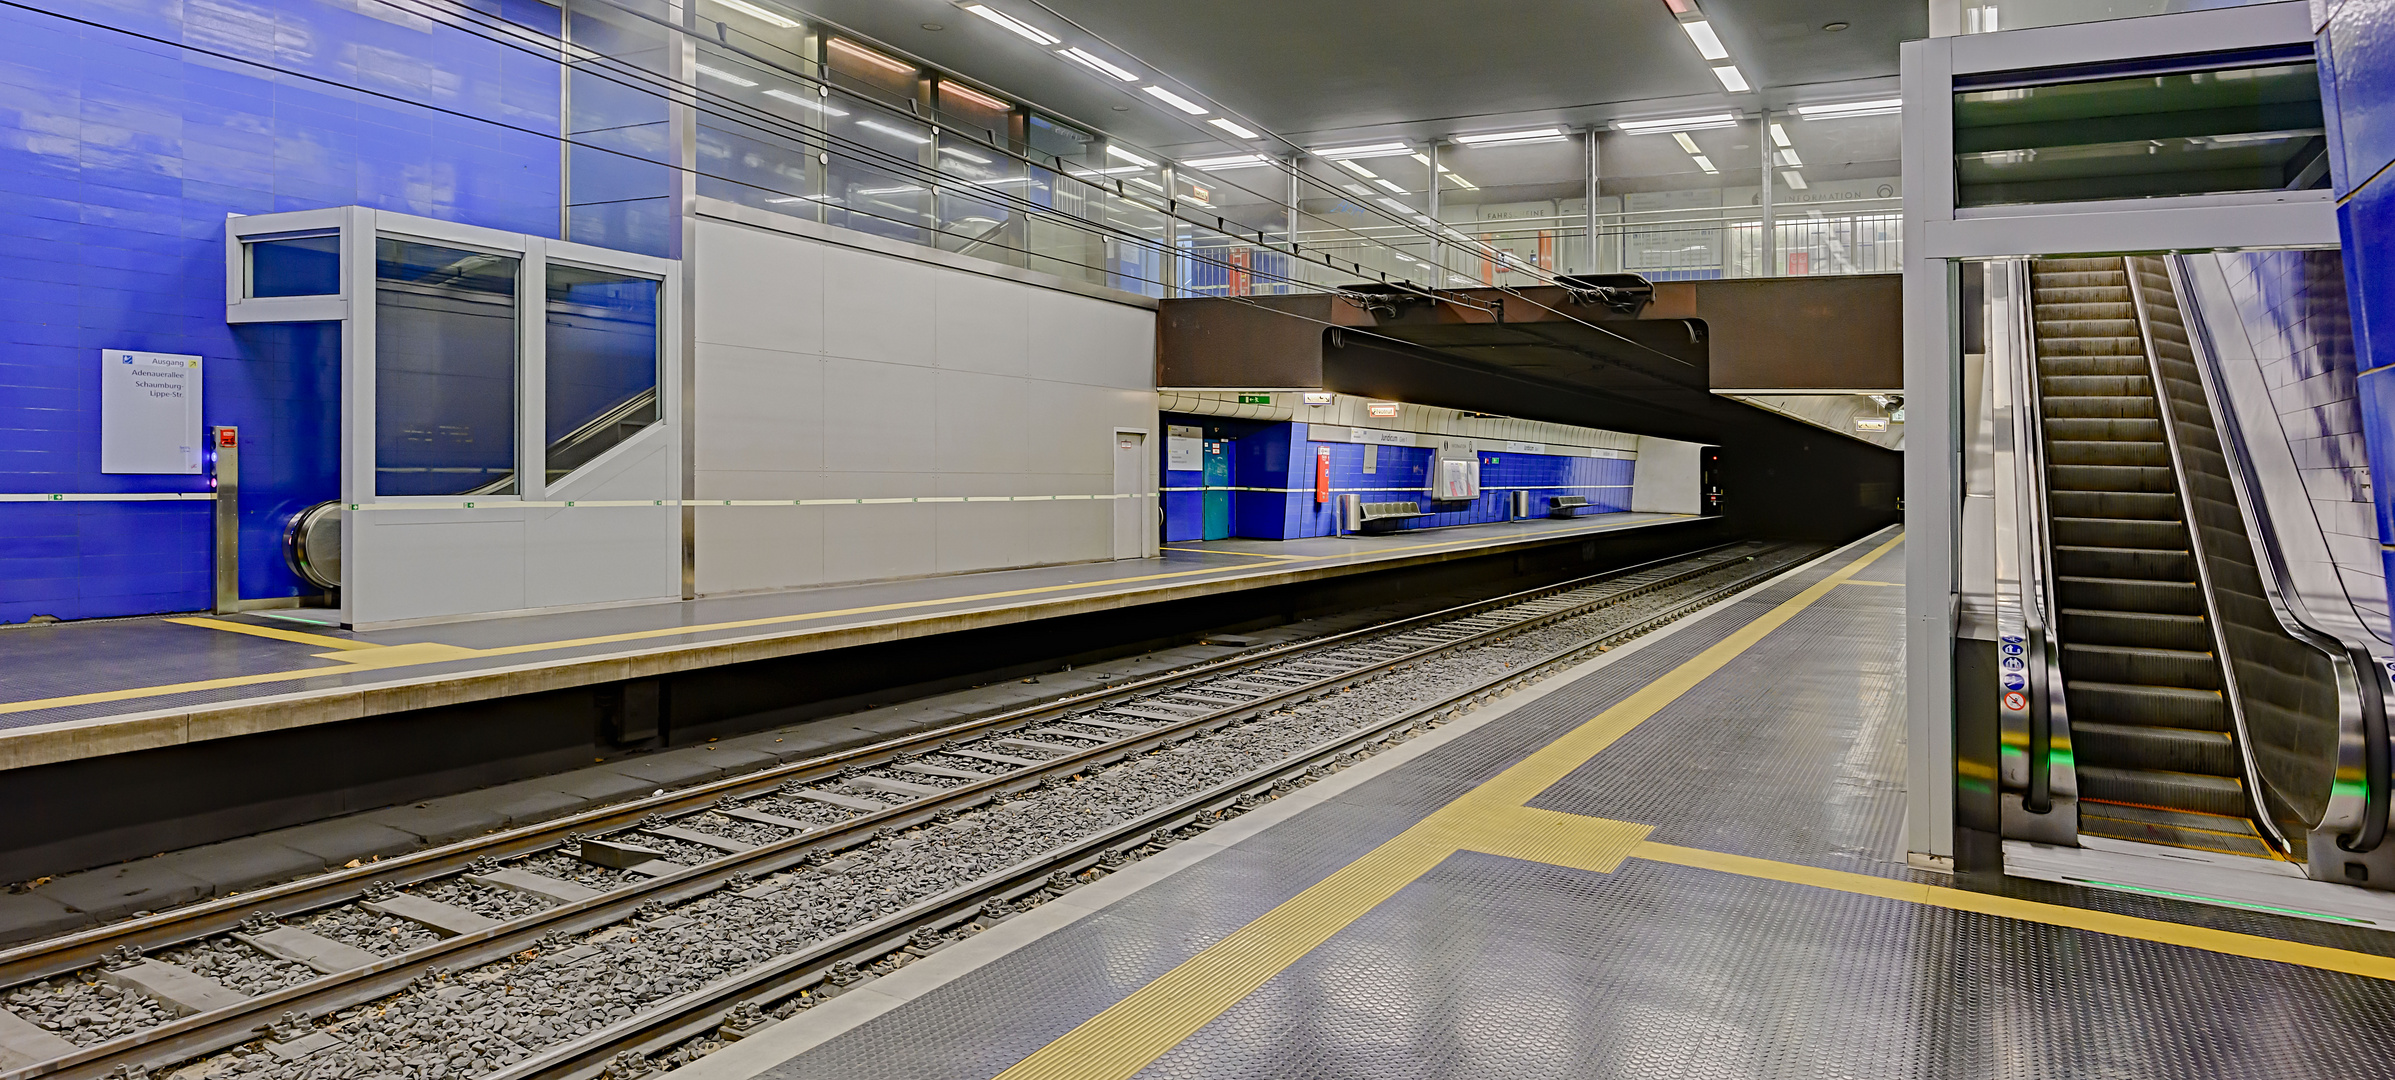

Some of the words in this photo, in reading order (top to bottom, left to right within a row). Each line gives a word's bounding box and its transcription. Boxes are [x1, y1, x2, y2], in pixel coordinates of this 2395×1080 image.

[1784, 191, 1862, 203] INFORMATION
[152, 358, 185, 367] Ausgang
[131, 369, 185, 378] Adenauerallee
[135, 381, 184, 390] Schaumburg-
[149, 390, 184, 398] Lippe-Str.
